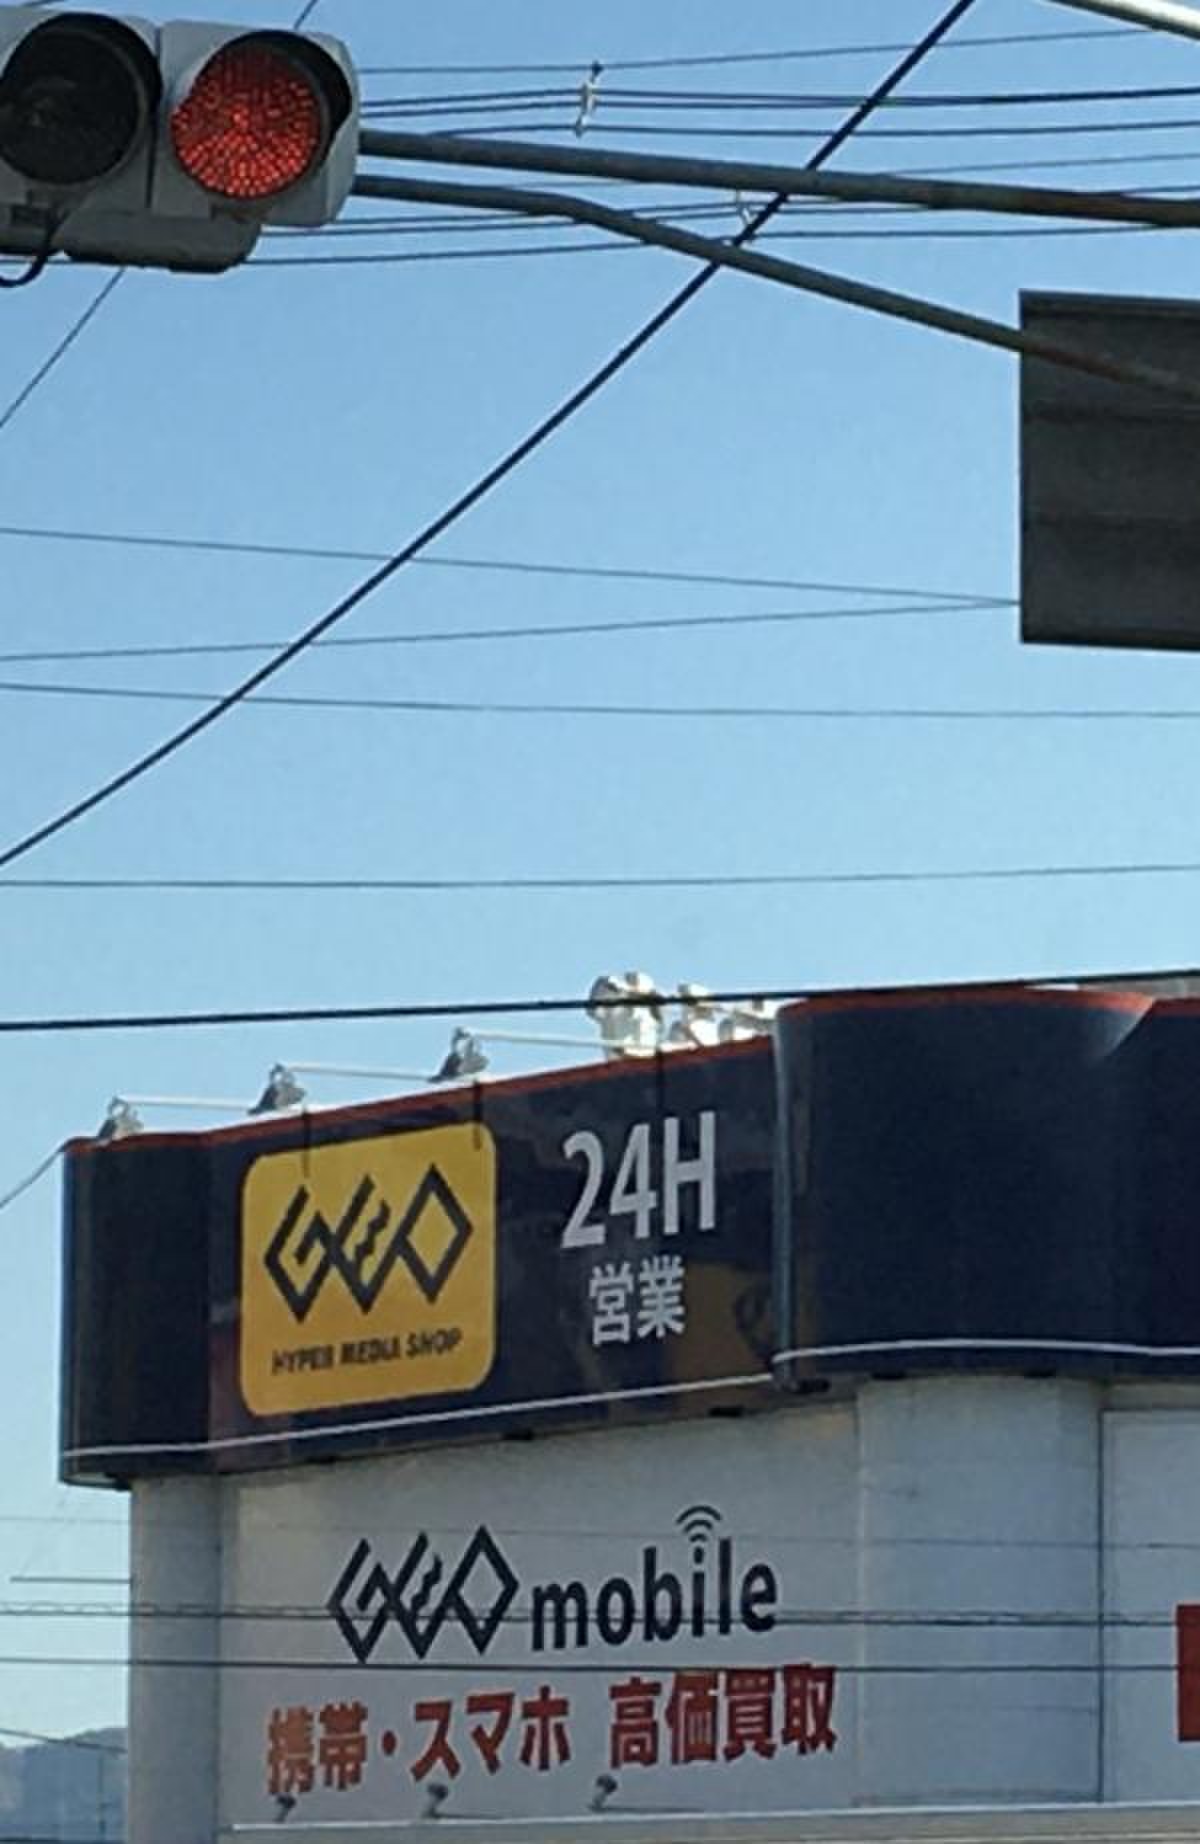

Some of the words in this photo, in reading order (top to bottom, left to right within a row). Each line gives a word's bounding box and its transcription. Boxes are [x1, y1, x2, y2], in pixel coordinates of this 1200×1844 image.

[562, 1110, 716, 1249] 24H
[272, 1345, 334, 1376] HYPER
[340, 1336, 400, 1365] MEDIA
[406, 1327, 463, 1357] SHOP
[589, 1254, 685, 1346] 営業
[531, 1536, 778, 1652] mobile
[268, 1685, 571, 1796] 携帯・スマホ
[609, 1662, 838, 1769] 高価買取
